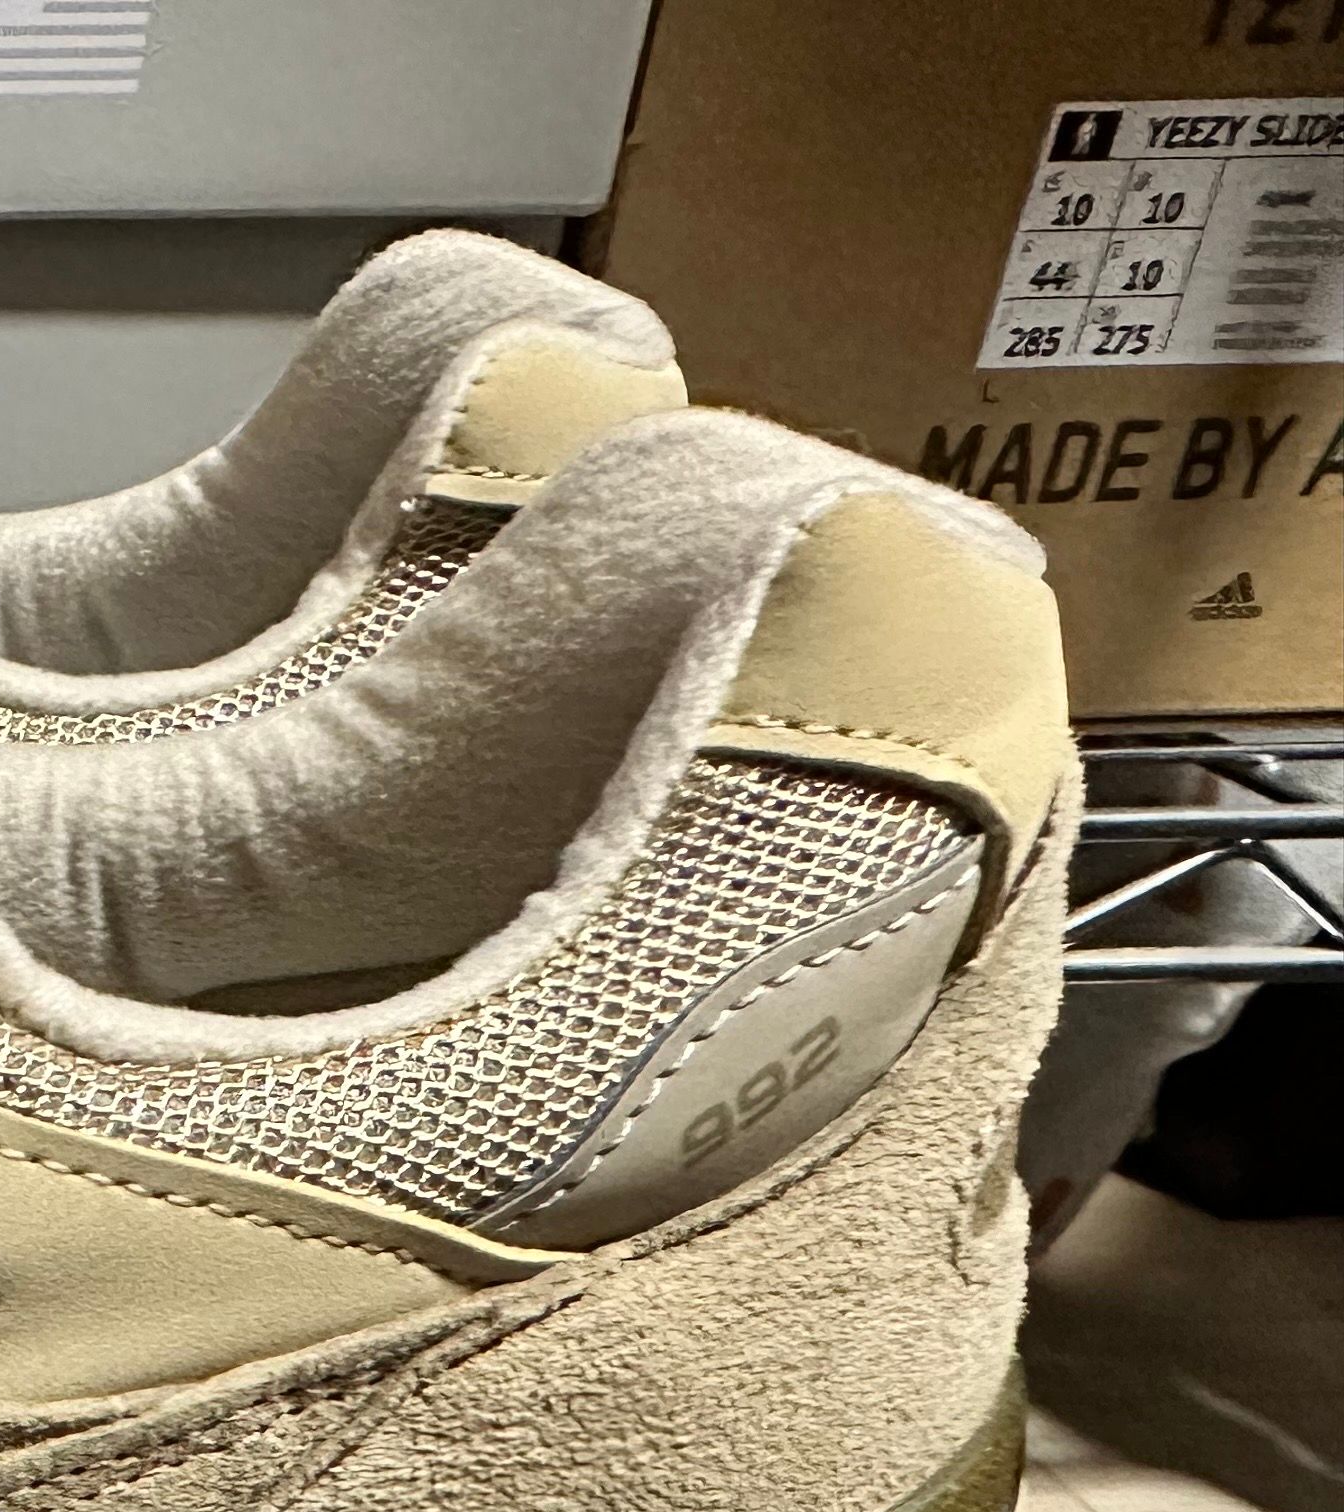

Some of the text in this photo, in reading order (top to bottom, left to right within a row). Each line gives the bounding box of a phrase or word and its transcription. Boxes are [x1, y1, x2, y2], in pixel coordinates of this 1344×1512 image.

[1146, 115, 1250, 148] YEEZY
[1141, 192, 1184, 224] 10
[1121, 259, 1163, 291] 10
[918, 420, 1162, 504] MADE
[1173, 415, 1298, 500] BY
[682, 1016, 841, 1169] 992
